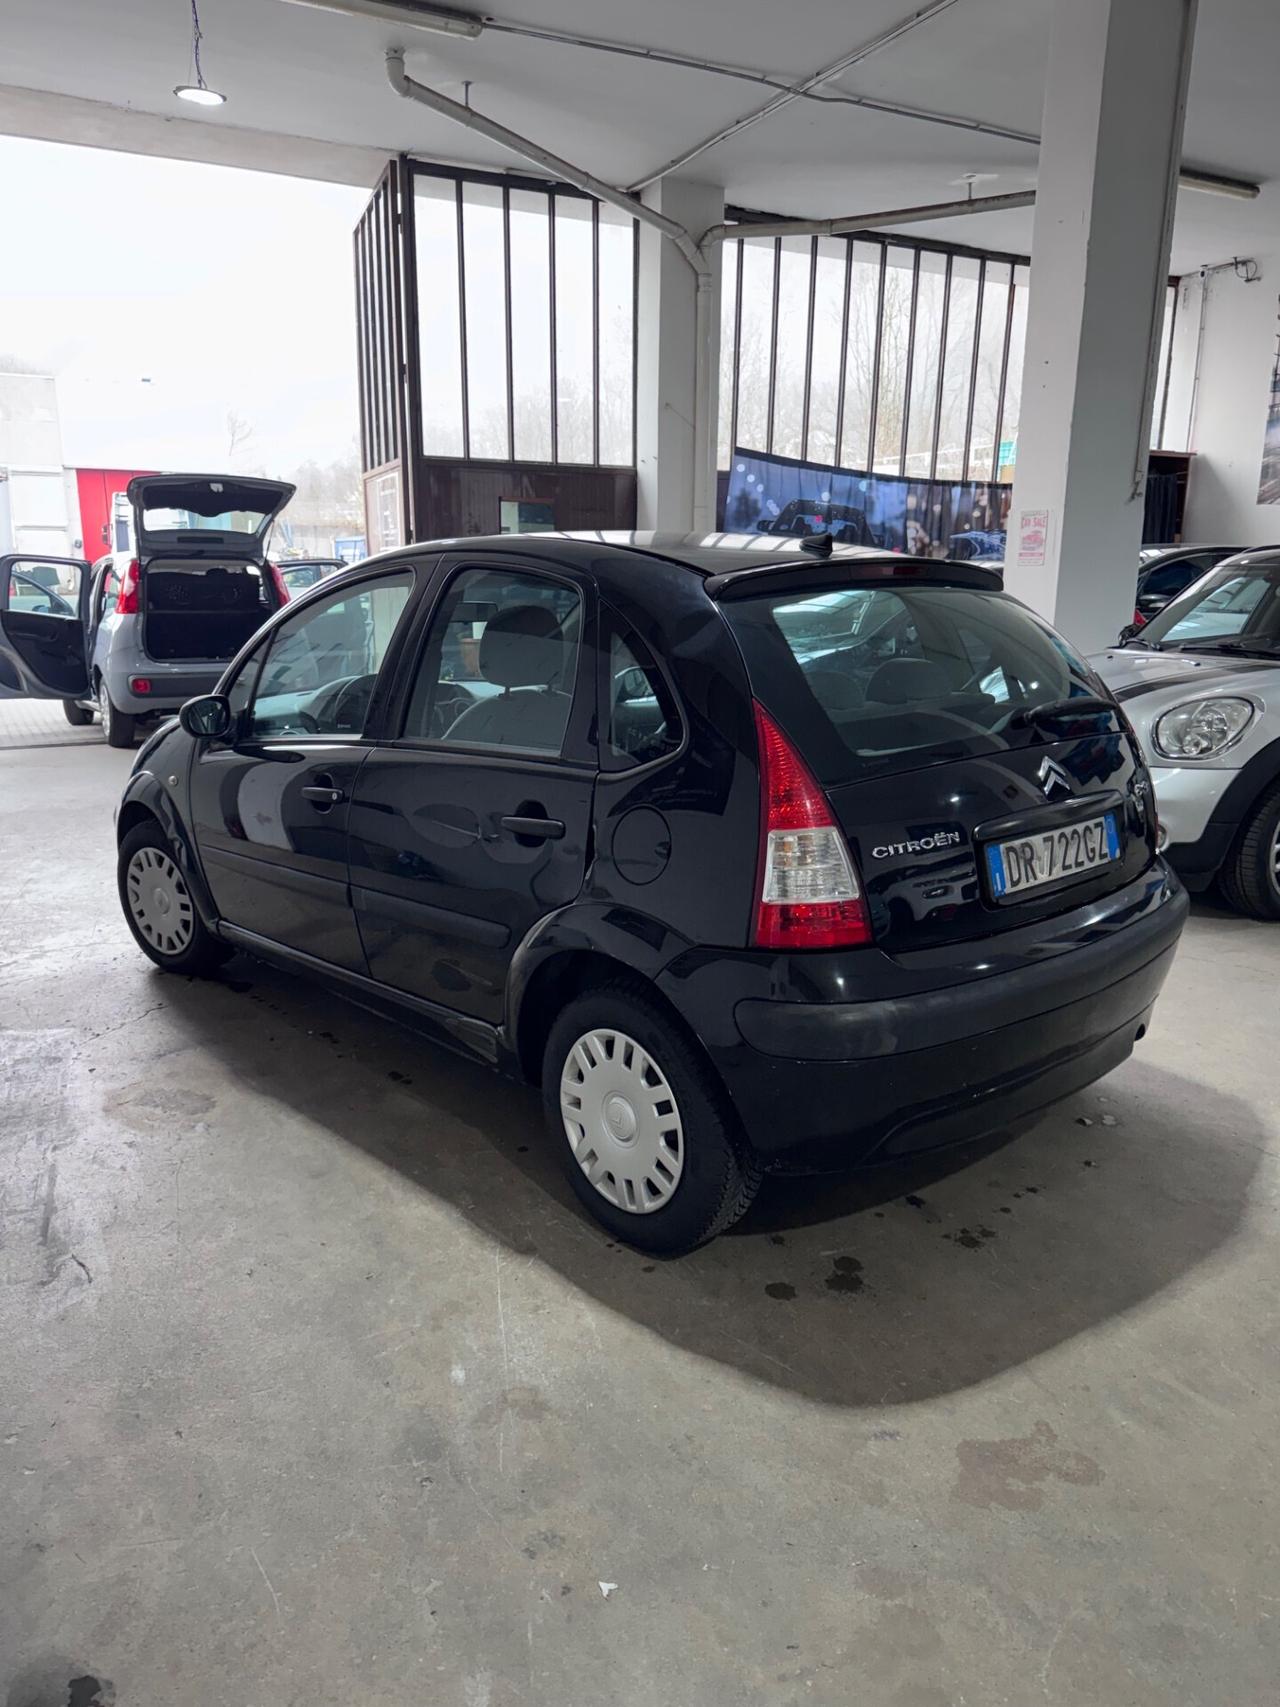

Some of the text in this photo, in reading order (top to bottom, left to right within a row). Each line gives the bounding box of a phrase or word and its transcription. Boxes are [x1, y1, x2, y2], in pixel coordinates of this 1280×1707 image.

[872, 831, 960, 858] CITROËN
[1005, 821, 1108, 889] DR 722GZ
